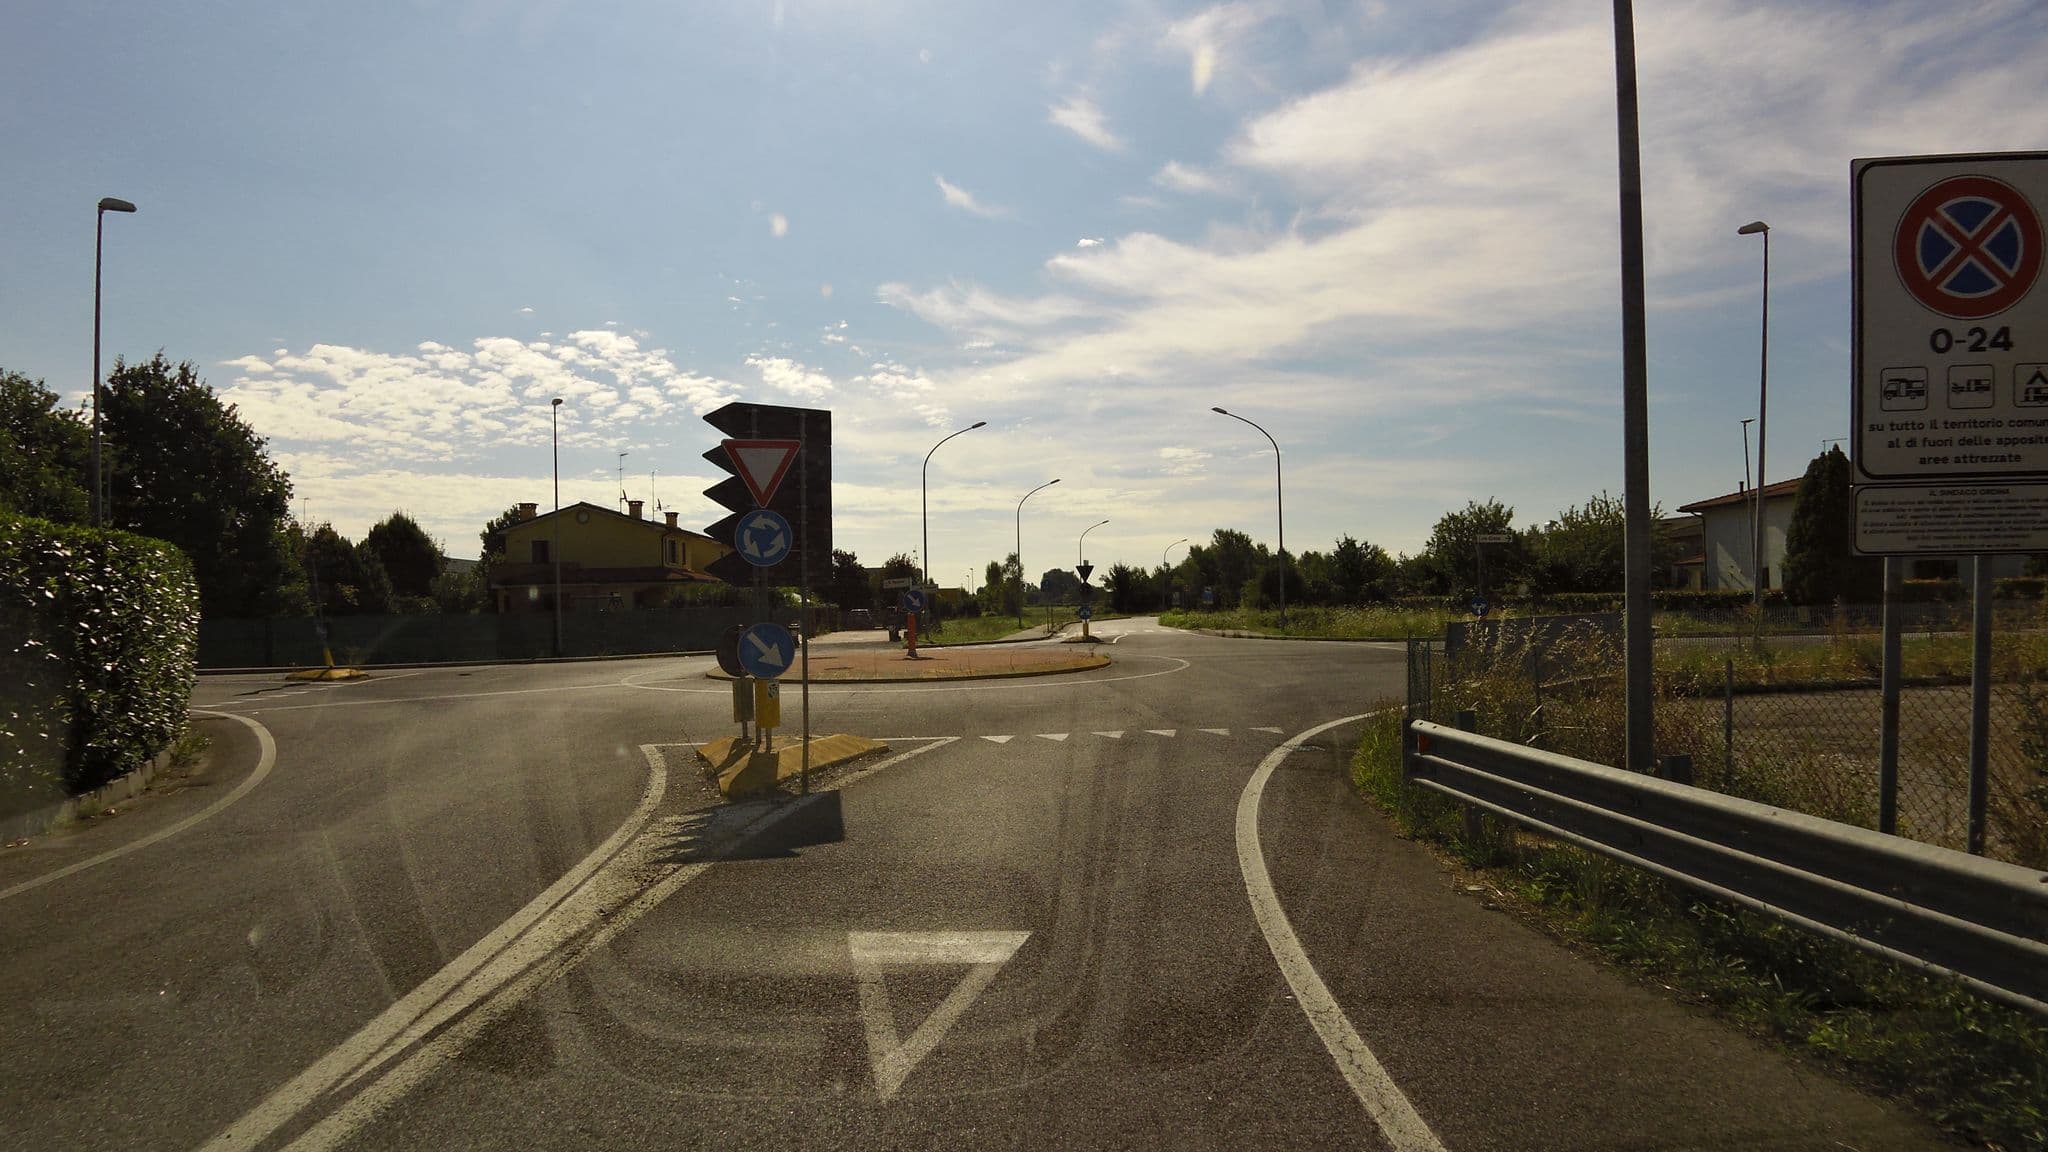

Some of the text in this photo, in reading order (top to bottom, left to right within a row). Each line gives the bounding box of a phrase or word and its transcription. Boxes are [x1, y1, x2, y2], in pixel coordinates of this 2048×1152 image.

[1929, 326, 2014, 354] 0-24
[1868, 422, 1885, 432] su
[1889, 420, 1925, 432] tutto
[1930, 419, 1939, 431] il
[1944, 418, 2004, 430] territorio
[1888, 438, 1900, 449] al
[1905, 437, 1917, 449] di
[1922, 436, 1953, 449] fuori
[1958, 435, 1992, 447] delle
[1919, 453, 2022, 465] aree attrezzate
